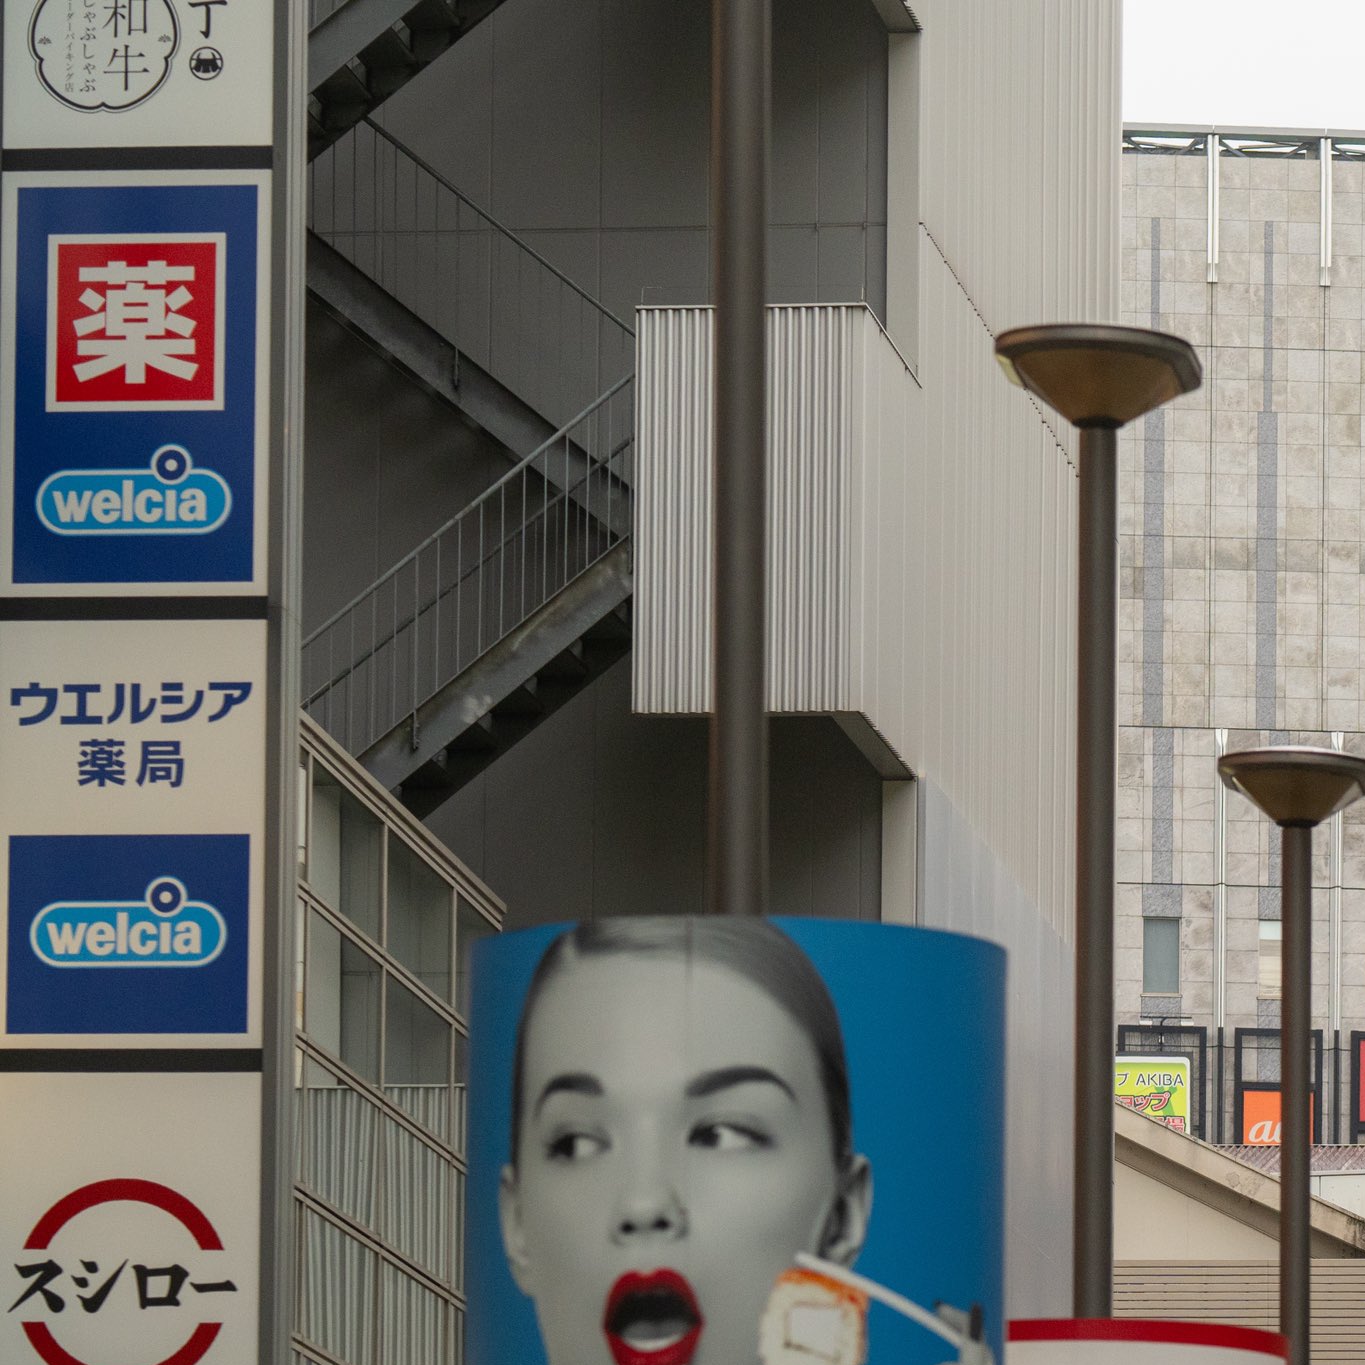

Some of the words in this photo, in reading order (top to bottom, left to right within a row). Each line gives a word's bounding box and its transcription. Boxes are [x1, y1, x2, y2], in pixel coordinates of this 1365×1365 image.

[102, 0, 150, 91] 和牛
[73, 259, 198, 384] 薬
[52, 480, 207, 523] welcia
[10, 681, 253, 726] ウエルシア
[77, 738, 185, 788] 薬局
[47, 911, 201, 956] welcia
[1136, 1073, 1184, 1086] AKIBA
[8, 1259, 238, 1313] スシロー
